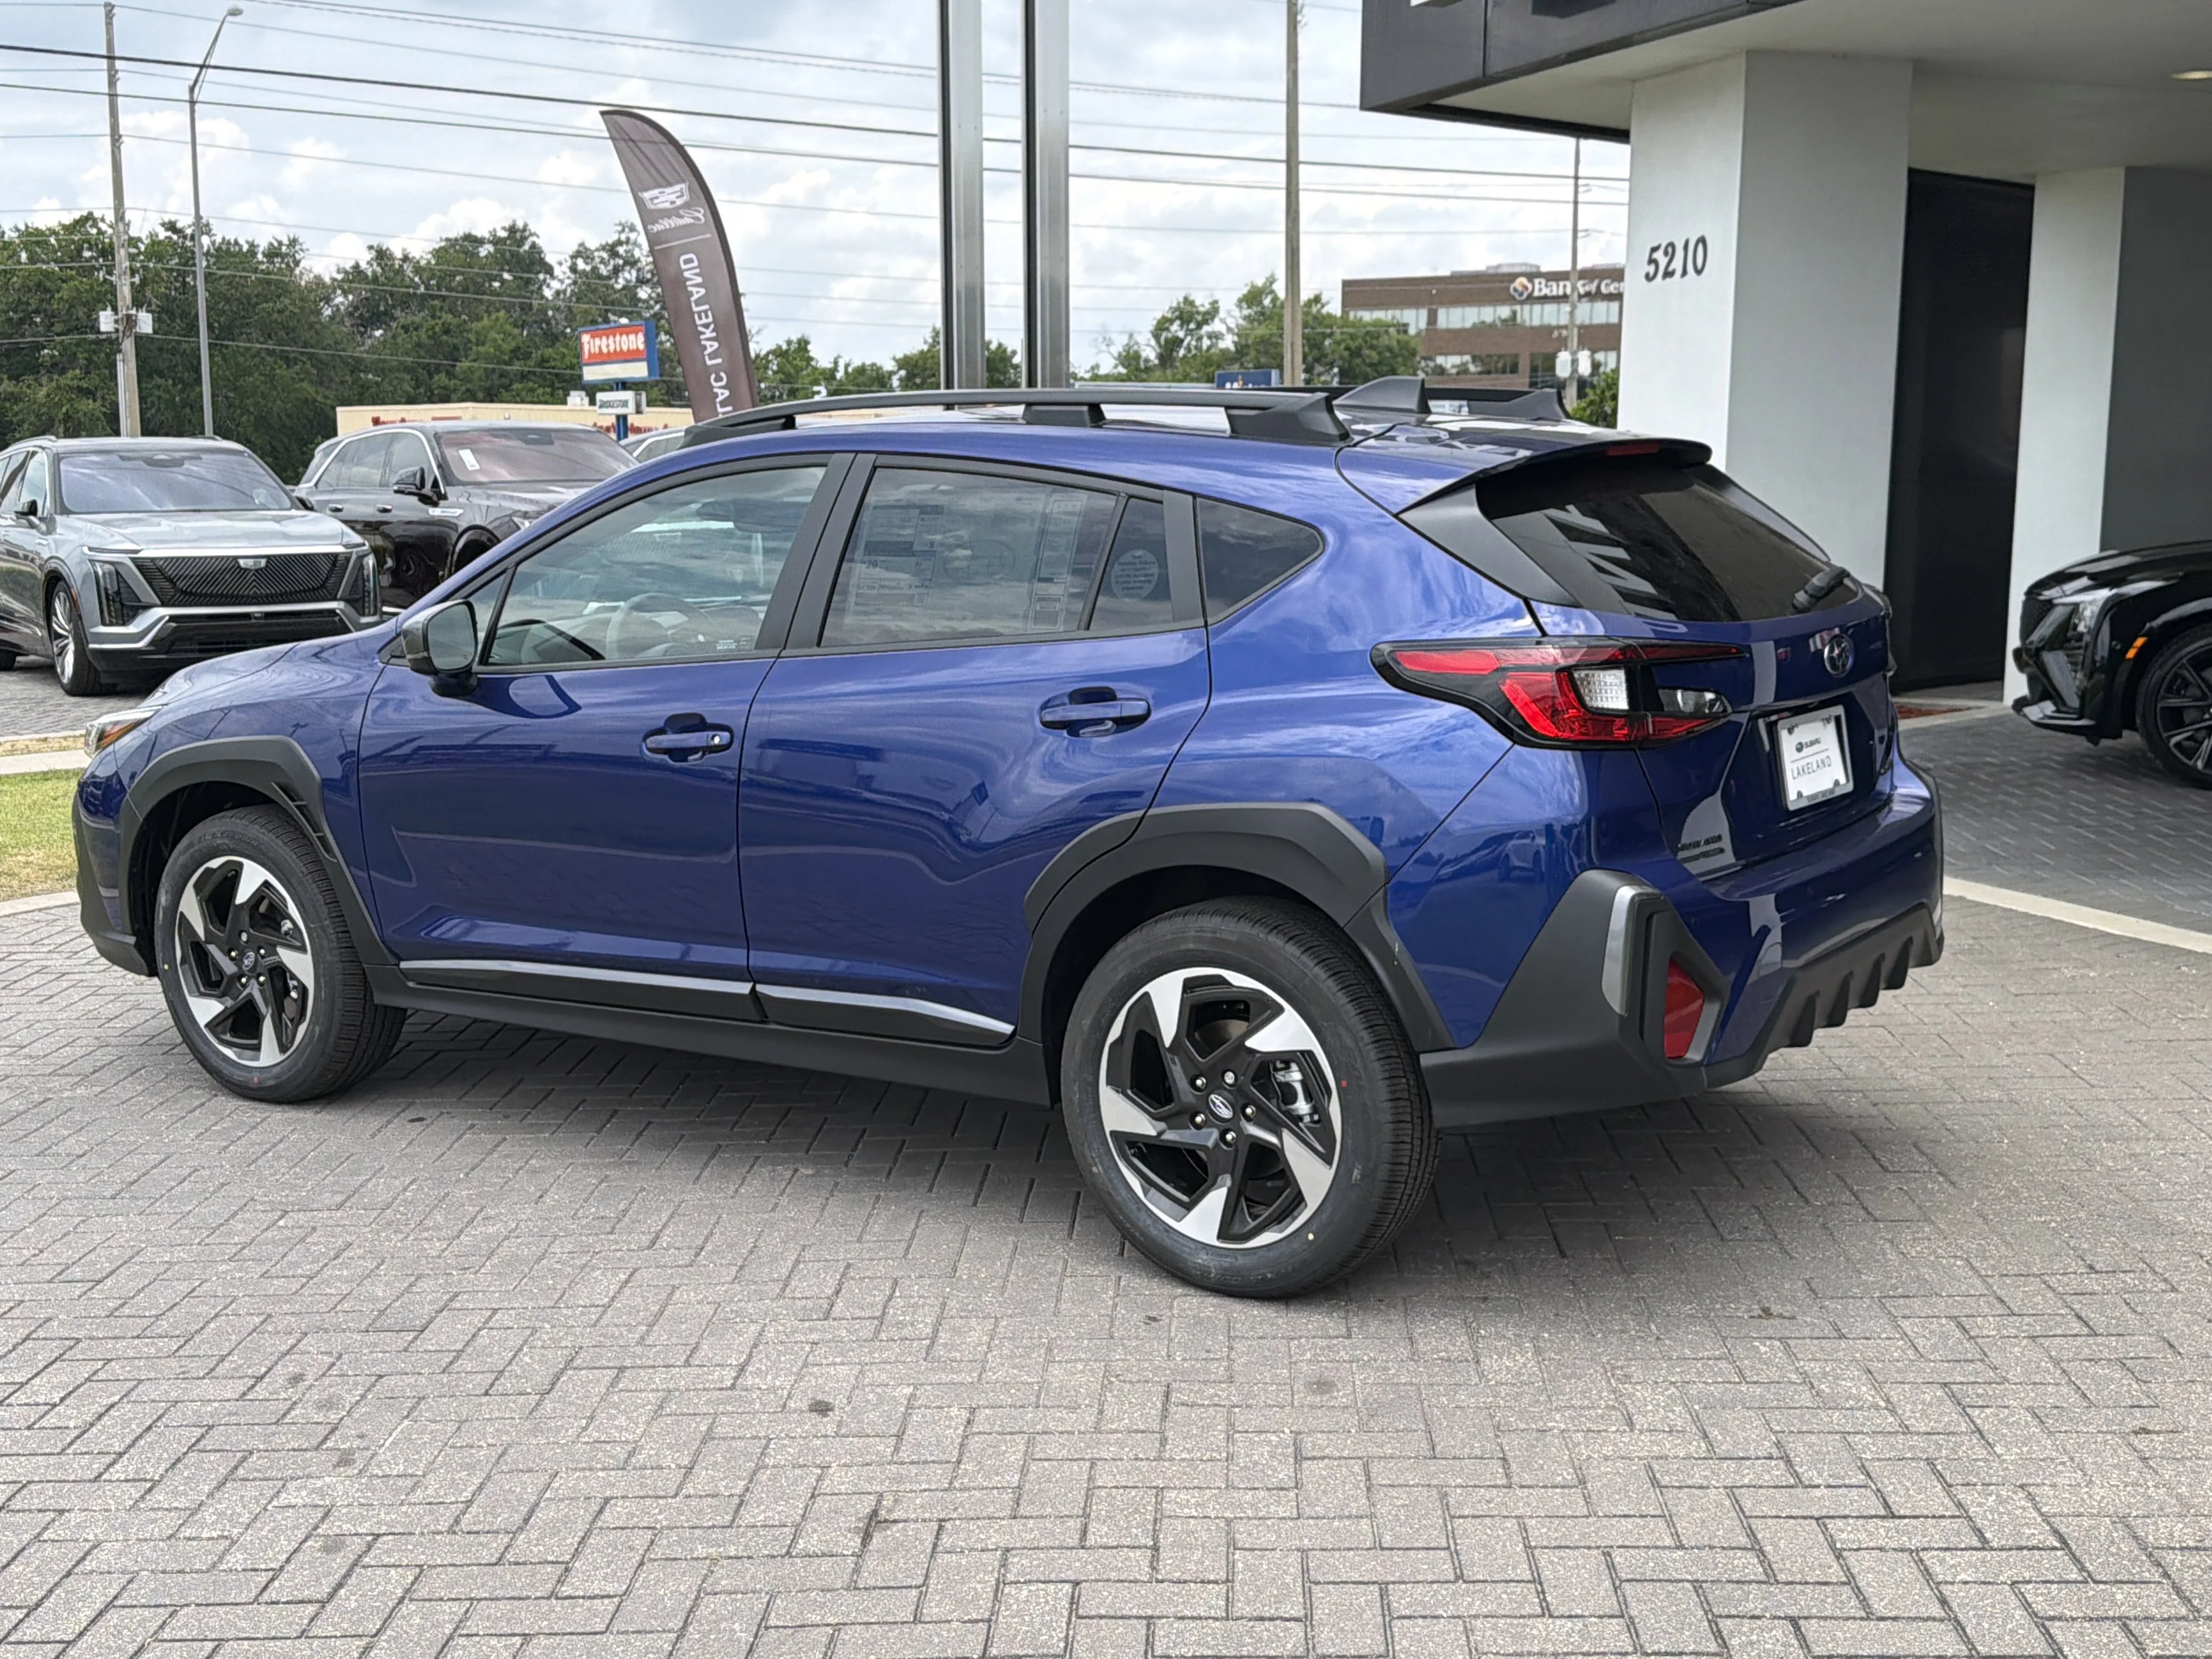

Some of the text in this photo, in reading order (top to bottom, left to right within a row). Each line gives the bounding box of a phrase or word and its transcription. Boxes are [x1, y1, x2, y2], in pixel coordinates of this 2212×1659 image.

[1645, 234, 1707, 282] 5210
[581, 331, 645, 360] Firestone
[1791, 755, 1832, 780] LAKELAND
